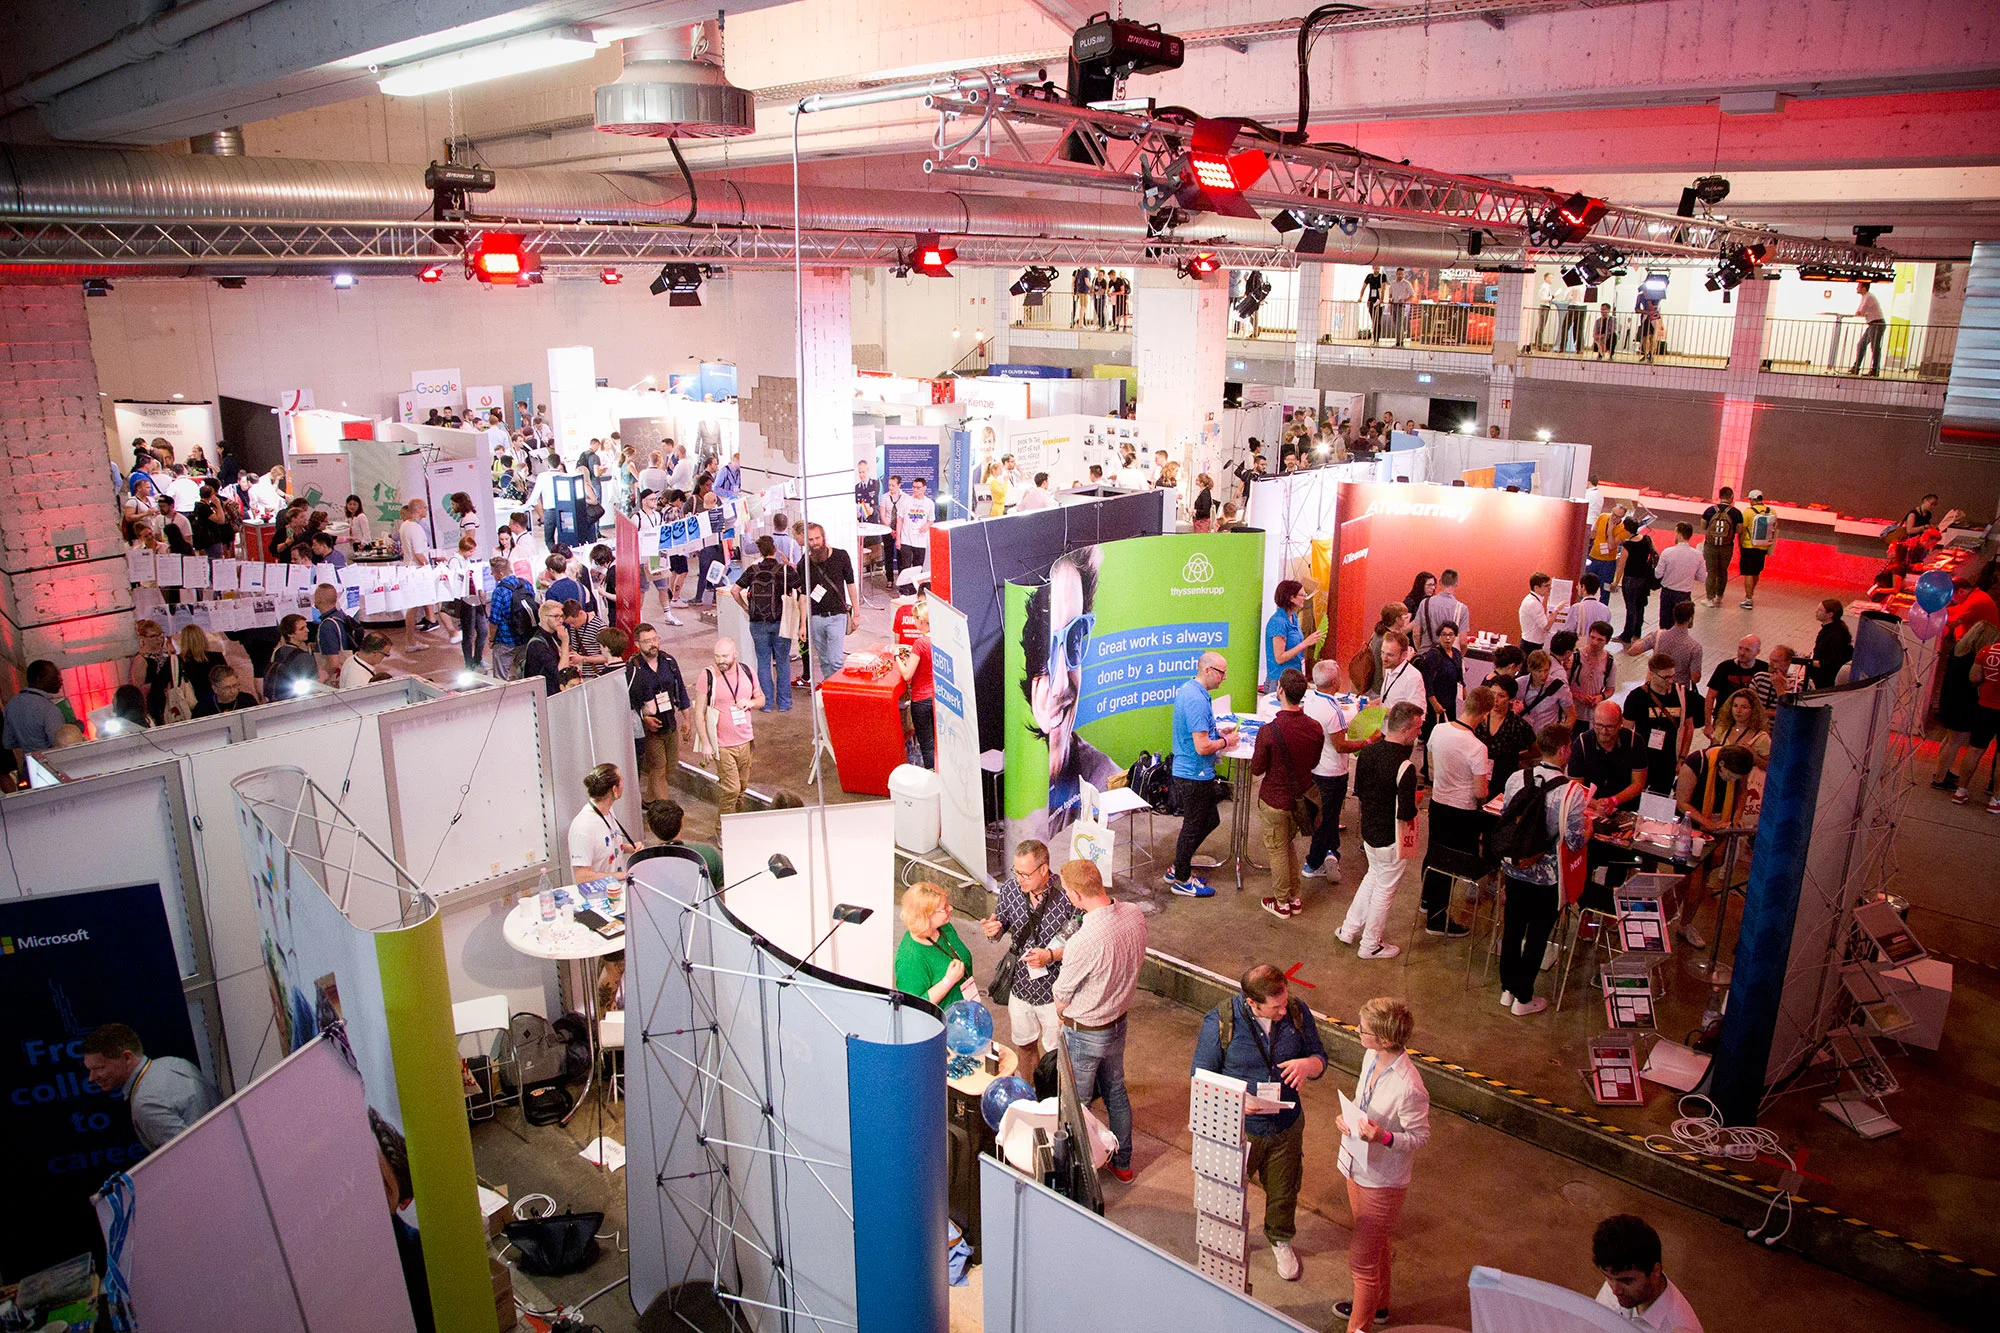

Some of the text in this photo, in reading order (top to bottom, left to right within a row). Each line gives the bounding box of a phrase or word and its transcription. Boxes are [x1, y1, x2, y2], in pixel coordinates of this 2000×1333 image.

[416, 380, 457, 395] Google
[148, 408, 177, 417] smava
[1170, 586, 1225, 596] thyssenkrupp
[1098, 629, 1223, 656] Great work is always
[1097, 657, 1198, 685] done by a bunch
[1096, 696, 1107, 713] of
[1109, 691, 1138, 713] great
[17, 928, 90, 950] Microsoft
[24, 1037, 84, 1068] Fro
[69, 1111, 112, 1134] to
